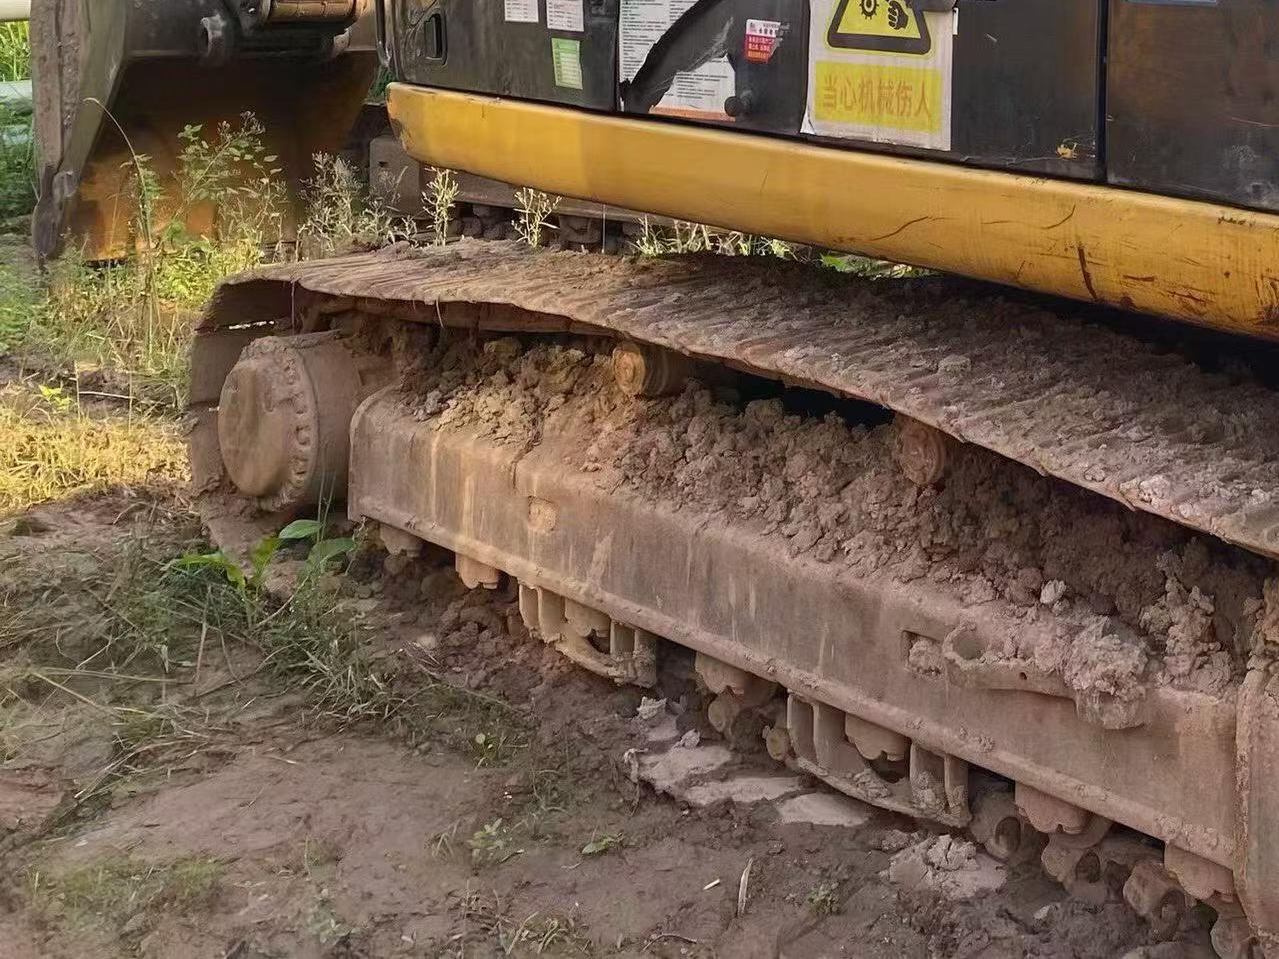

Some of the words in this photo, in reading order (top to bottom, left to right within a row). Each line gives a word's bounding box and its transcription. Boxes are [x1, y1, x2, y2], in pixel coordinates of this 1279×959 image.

[822, 73, 933, 131] 当心机械伤人
